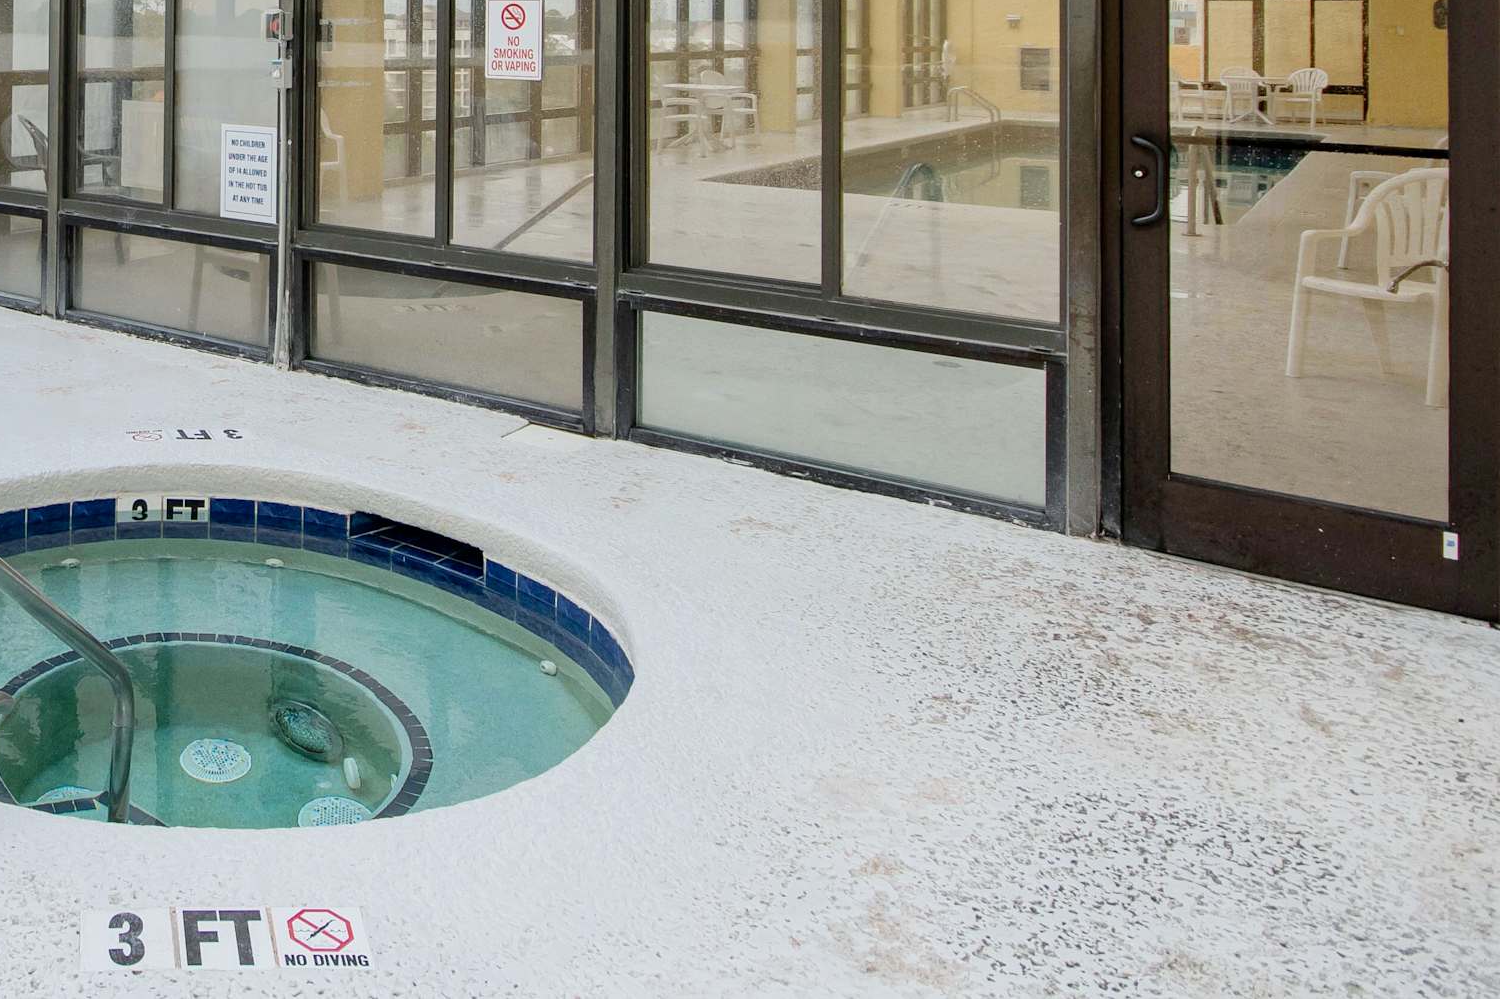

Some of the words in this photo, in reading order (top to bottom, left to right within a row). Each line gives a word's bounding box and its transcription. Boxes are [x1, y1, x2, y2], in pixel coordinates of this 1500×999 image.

[507, 36, 520, 47] NO
[493, 48, 534, 60] SMOKING
[491, 60, 503, 71] OR
[505, 60, 536, 72] VAPING
[240, 139, 265, 148] CHILDREN
[228, 153, 245, 161] UNDER
[247, 153, 257, 163] THE
[258, 155, 268, 163] AGE
[228, 166, 236, 174] OF
[243, 168, 267, 177] ALLOWED
[228, 180, 234, 188] IN
[235, 181, 244, 189] THE
[246, 182, 256, 190] HOT
[257, 183, 267, 191] TUB
[232, 194, 239, 202] AT
[251, 196, 264, 205] TIME
[175, 429, 212, 440] FT
[223, 429, 244, 440] 3
[132, 498, 148, 521] 3
[166, 498, 206, 521] FT
[108, 912, 146, 966] 3
[182, 909, 262, 966] FT
[284, 953, 308, 967] NO
[313, 953, 370, 967] DIVING
